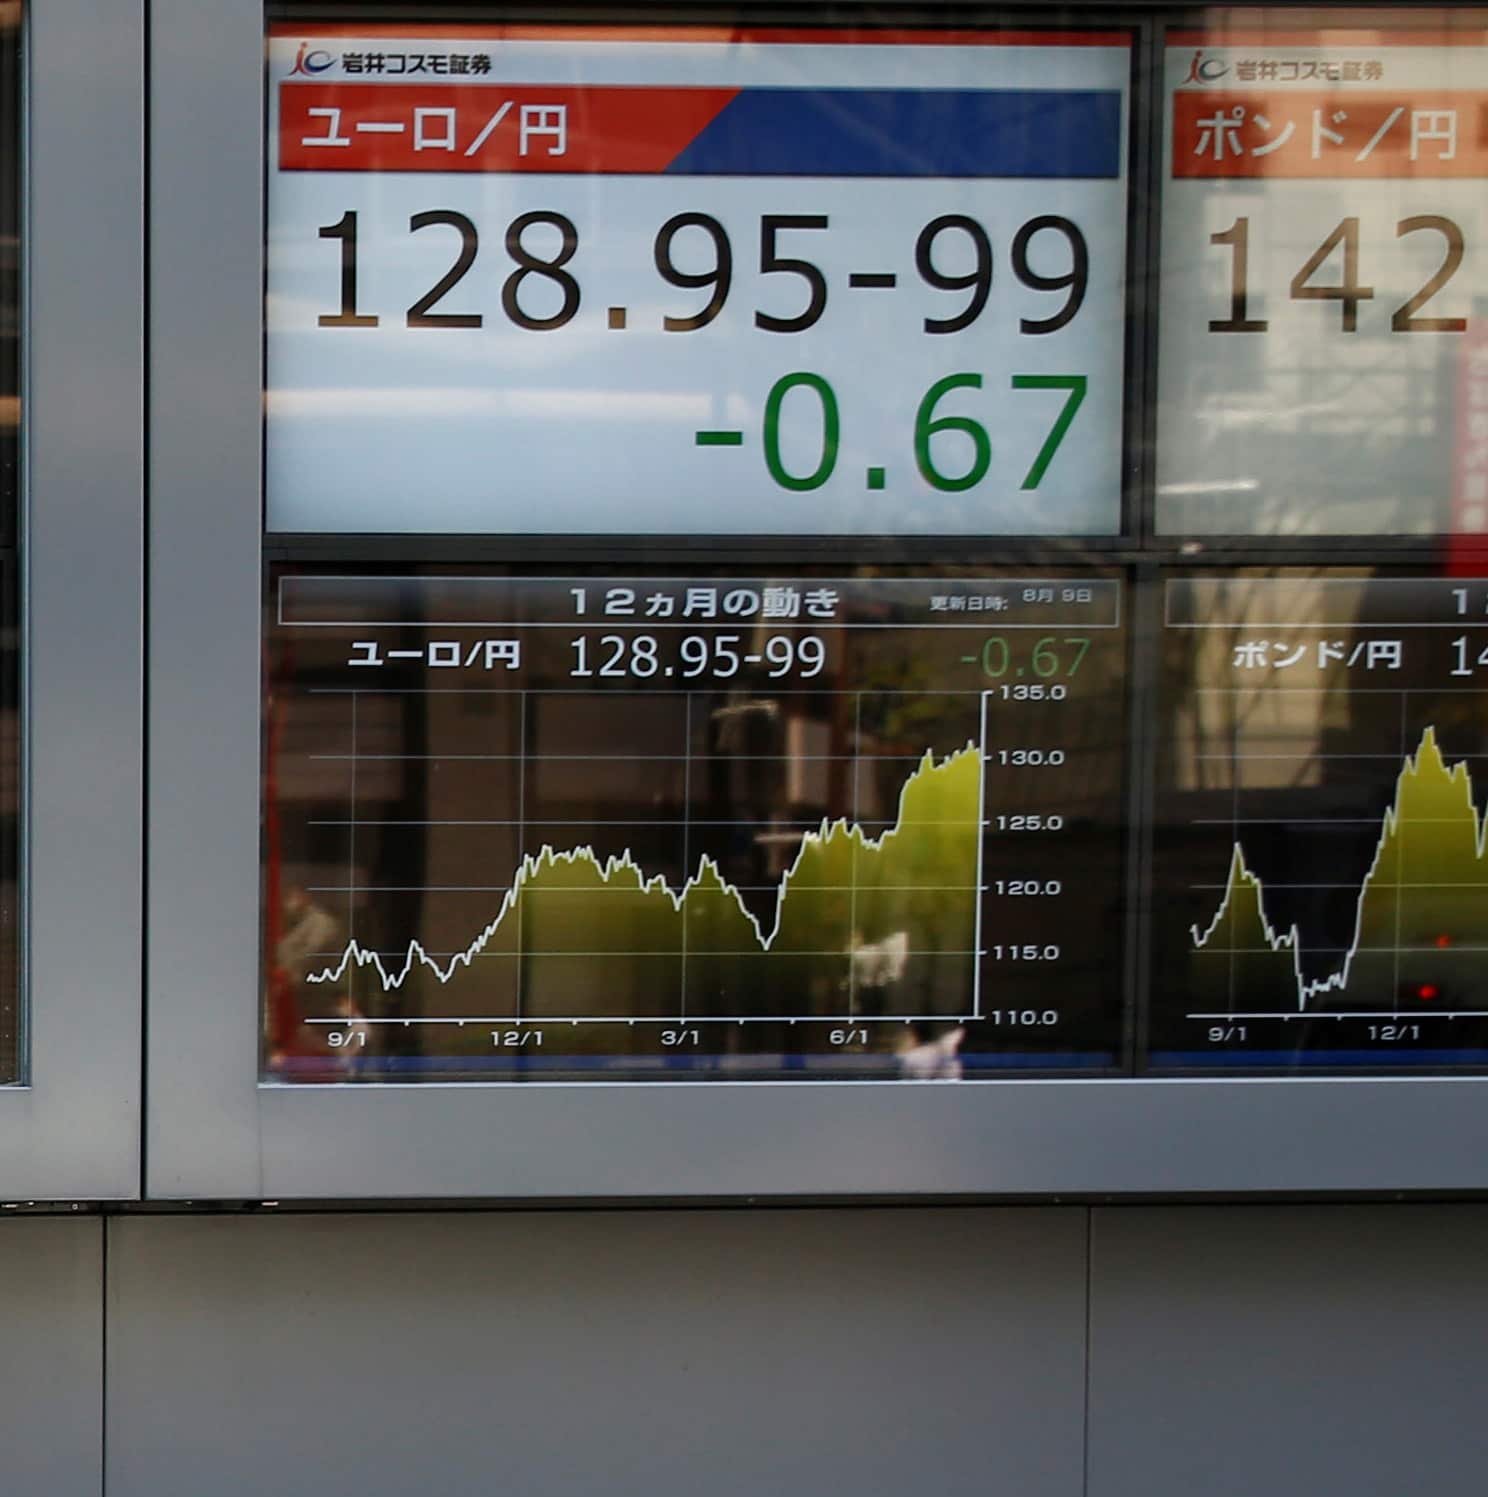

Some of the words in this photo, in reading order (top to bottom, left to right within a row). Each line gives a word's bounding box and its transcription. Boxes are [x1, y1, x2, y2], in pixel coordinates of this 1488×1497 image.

[342, 52, 492, 75] 岩井コスモ証券
[1236, 60, 1384, 81] 岩井コスモ証券
[301, 100, 568, 156] ユーロ/円
[1194, 106, 1457, 162] ポンド/円
[317, 209, 1089, 334] 128.95-99
[1208, 214, 1467, 333] 142
[695, 371, 1087, 492] -0.67
[348, 640, 521, 670] ユーロ/円
[569, 635, 825, 678] 128.95-99
[961, 637, 1091, 678] -0.67
[1233, 640, 1402, 670] ポンド/円
[1000, 685, 1066, 701] 135.0
[998, 750, 1065, 766] 130.0
[996, 815, 1063, 831] 125.0
[995, 880, 1061, 896] 120.0
[993, 945, 1060, 961] 115.0
[992, 1010, 1058, 1026] 110.0
[328, 1031, 367, 1047] 9/1
[490, 1031, 543, 1047] 12/1
[661, 1030, 699, 1046] 3/1
[830, 1029, 868, 1045] 6/1
[1208, 1026, 1247, 1041] 9/1
[1368, 1025, 1419, 1040] 12/1
